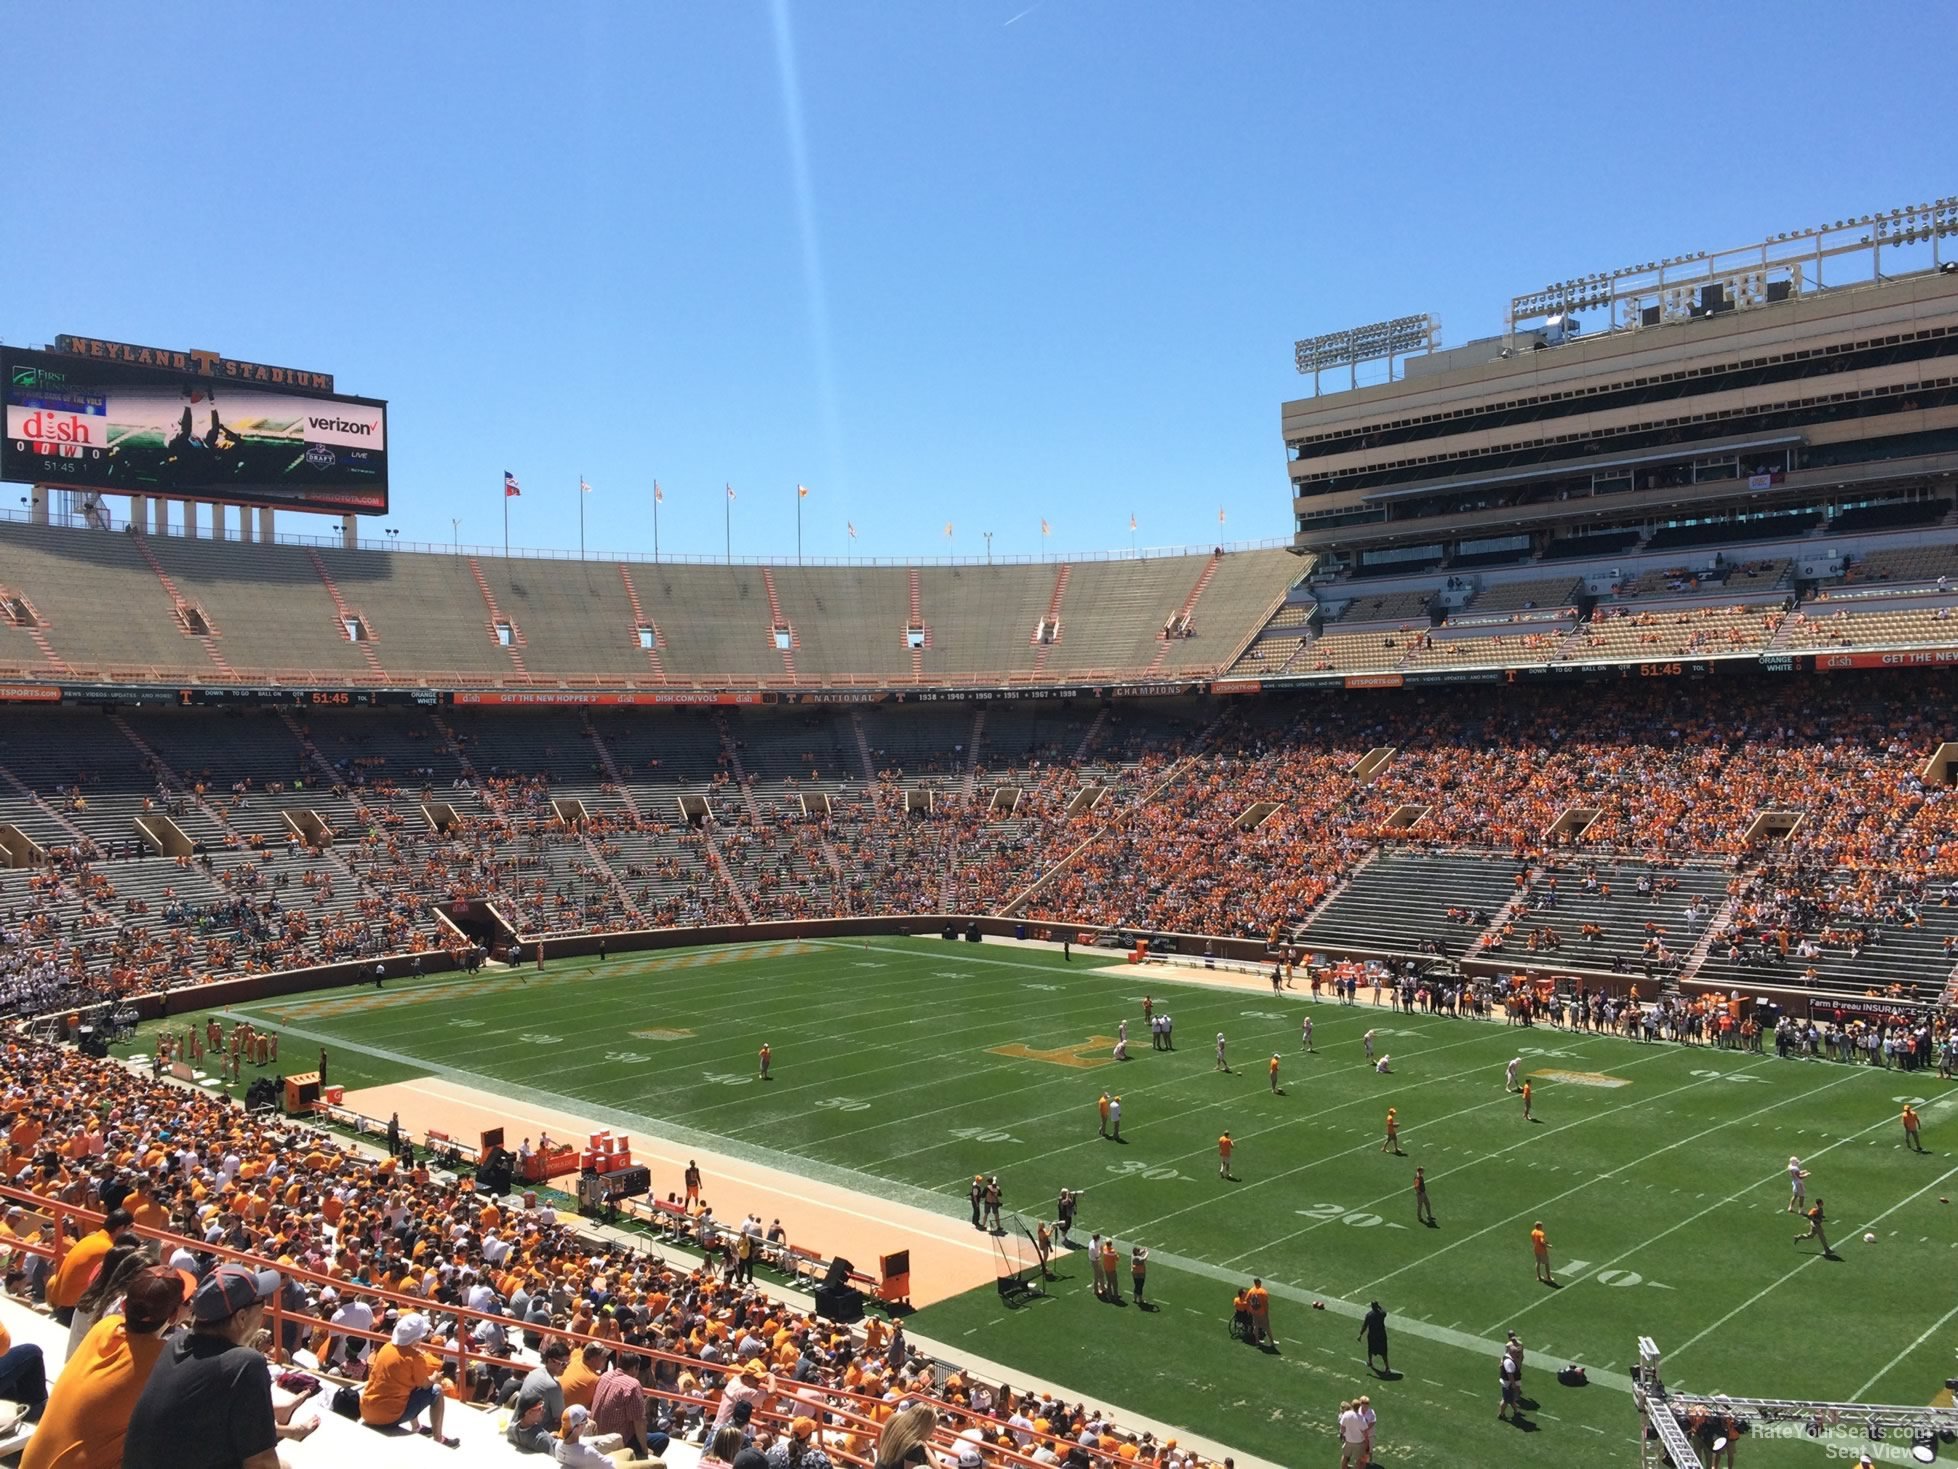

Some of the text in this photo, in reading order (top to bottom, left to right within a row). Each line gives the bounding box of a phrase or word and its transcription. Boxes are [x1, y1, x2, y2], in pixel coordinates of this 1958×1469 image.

[71, 338, 327, 388] NEYLAND T STADIUM
[38, 369, 65, 381] FIRST
[23, 411, 92, 444] dish
[308, 417, 371, 435] verizon
[44, 461, 75, 472] 51:45
[1759, 656, 1793, 664] ORANGE
[1828, 657, 1852, 667] dish
[1882, 655, 1904, 664] GET
[1909, 653, 1932, 662] THE
[1640, 663, 1682, 676] 51:45
[1505, 670, 1517, 683] T
[180, 690, 193, 704] T
[1117, 686, 1181, 696] CHAMPIONS
[313, 692, 349, 704] 51:45
[463, 693, 480, 703] dish
[501, 694, 515, 702] GET
[518, 694, 535, 702] THE
[536, 694, 556, 702] NEW
[557, 694, 588, 703] HOPPER
[618, 695, 635, 704] dish
[655, 695, 718, 703] DISH.COM/VOLS
[814, 694, 874, 702] NATIONAL
[1809, 999, 1831, 1008] Farm
[815, 1096, 872, 1112] 50
[948, 1127, 1011, 1143] 40
[1105, 1160, 1179, 1181] 30
[1295, 1203, 1384, 1228] 20
[1549, 1258, 1644, 1288] 10
